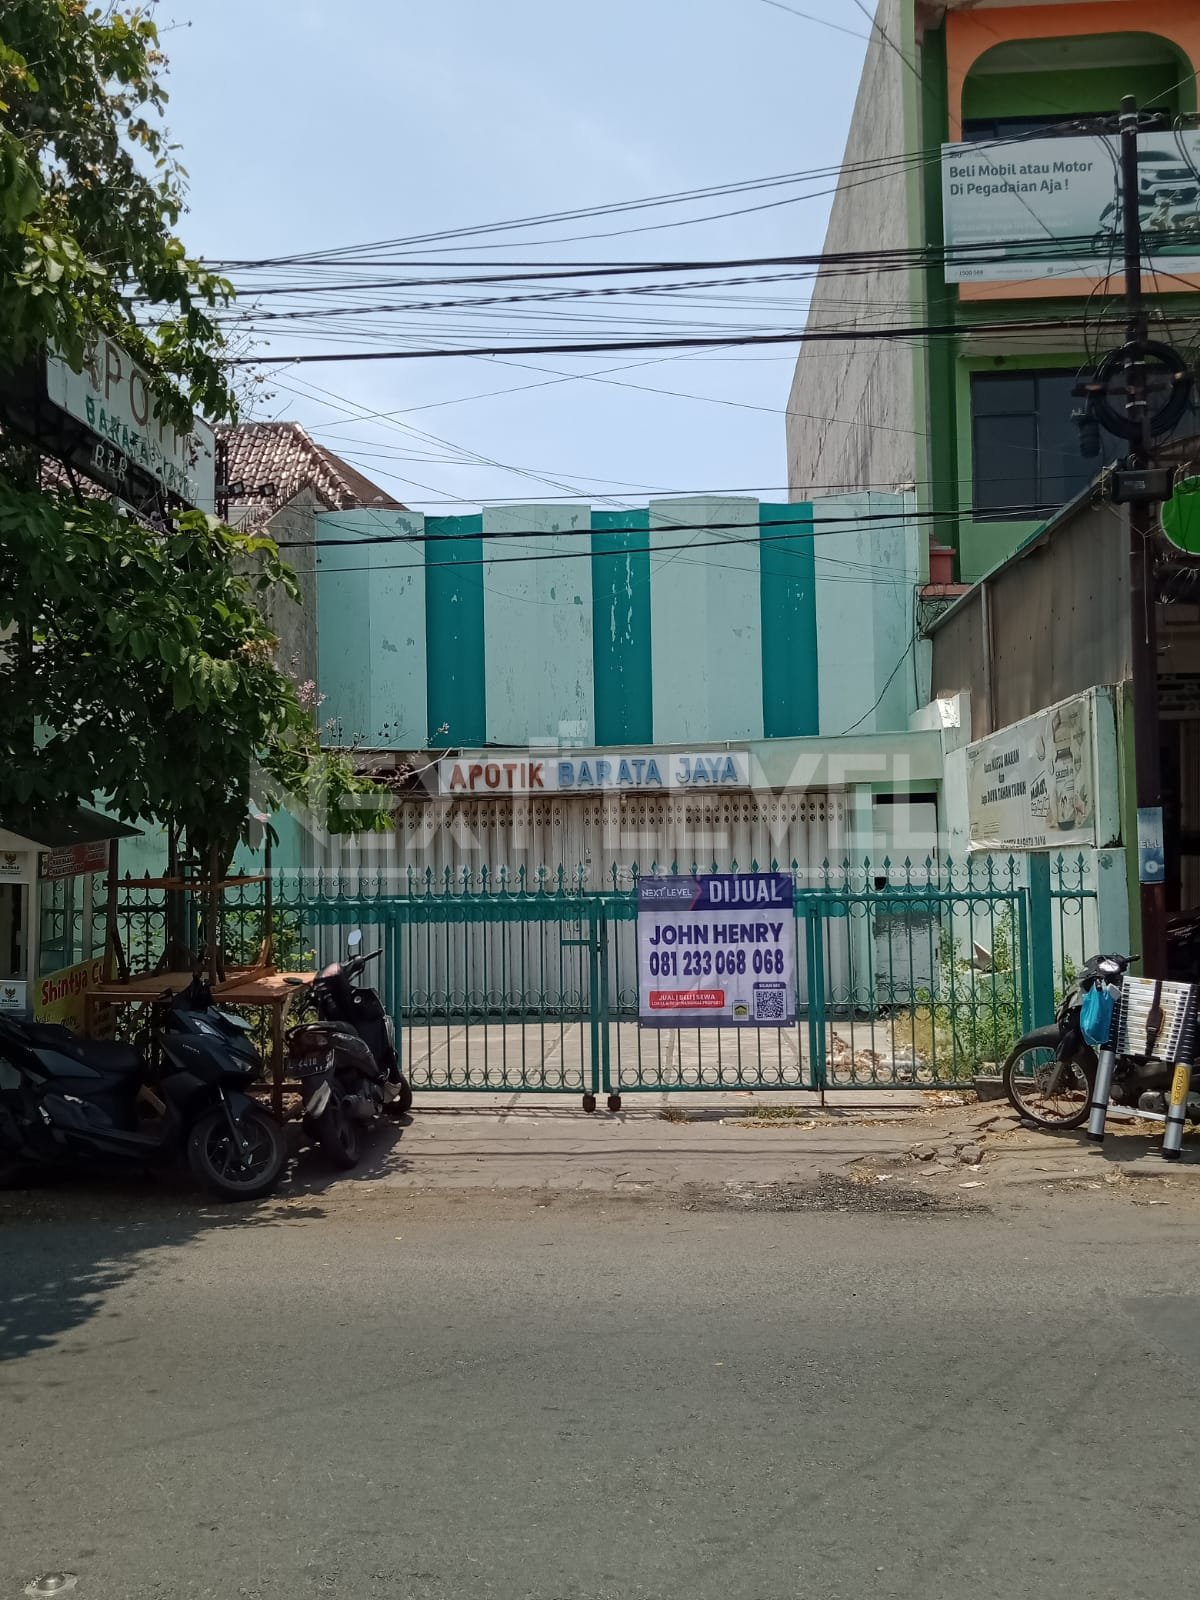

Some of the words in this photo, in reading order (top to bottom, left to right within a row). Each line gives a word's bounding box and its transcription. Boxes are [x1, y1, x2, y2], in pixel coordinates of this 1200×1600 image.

[949, 166, 975, 178] Beli
[979, 164, 1017, 177] Mobil
[1019, 164, 1050, 175] atau
[1053, 161, 1093, 173] Motor
[950, 183, 964, 196] Di
[966, 181, 1037, 197] Pegadaian
[449, 762, 545, 791] APOTIK
[558, 758, 663, 787] BARATA
[675, 755, 739, 784] JAYA
[641, 887, 665, 898] NEXT
[666, 887, 693, 898] LEVEL
[709, 879, 783, 903] DIJUAL
[649, 924, 709, 946] JOHN
[713, 922, 784, 945] HENRY
[649, 951, 677, 977] 081
[683, 950, 712, 976] 233
[715, 949, 746, 976] 068
[752, 948, 785, 975] 068
[41, 969, 88, 1006] Shintya
